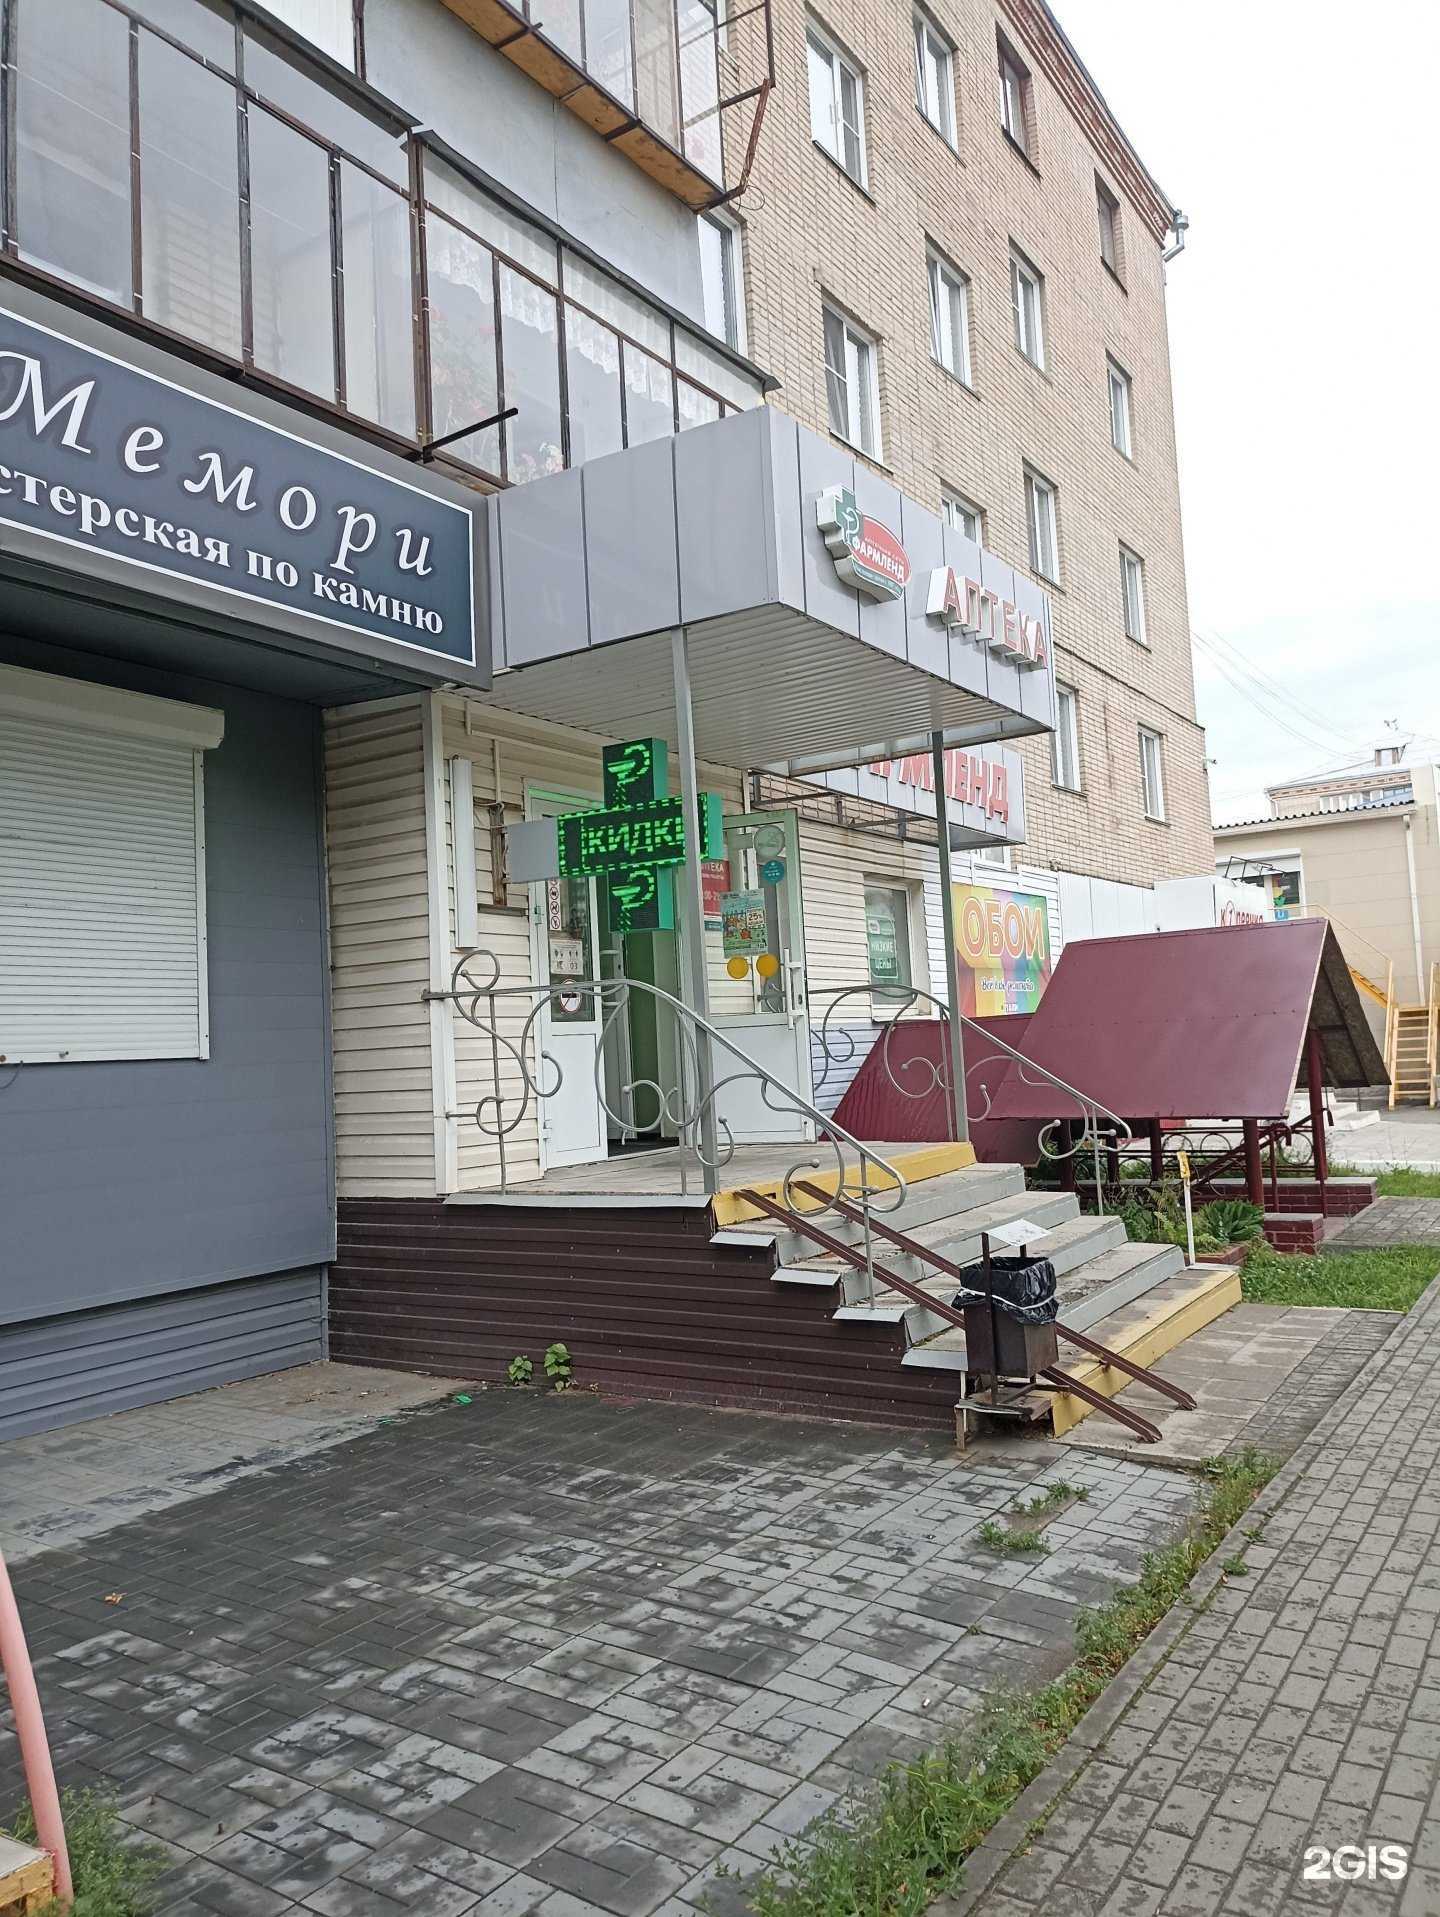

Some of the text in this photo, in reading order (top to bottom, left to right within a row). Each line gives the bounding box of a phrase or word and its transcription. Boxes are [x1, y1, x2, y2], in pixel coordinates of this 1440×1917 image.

[0, 351, 432, 575] Мемори
[246, 549, 299, 588] по
[312, 571, 443, 634] камню
[852, 536, 905, 585] ФАРМЛЕНД
[928, 565, 1048, 668] АПТЕКА
[961, 897, 1045, 960] ОБОИ
